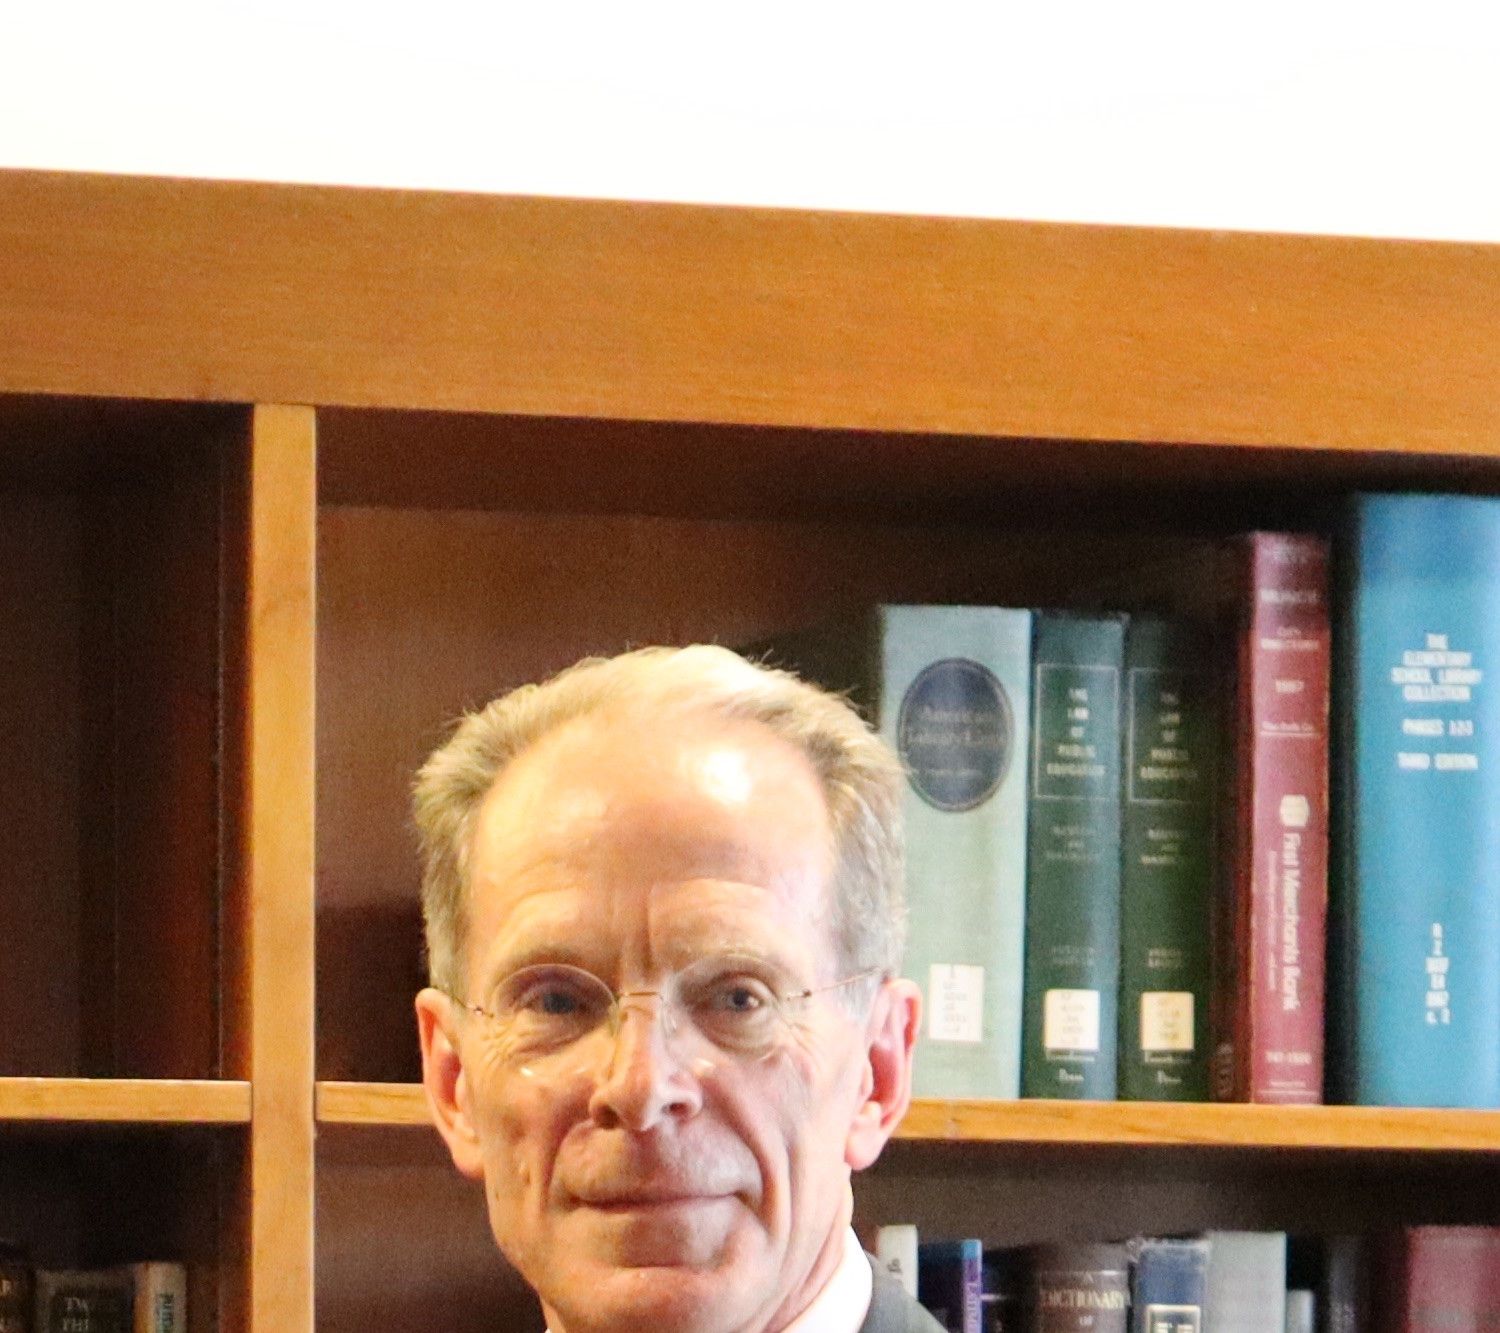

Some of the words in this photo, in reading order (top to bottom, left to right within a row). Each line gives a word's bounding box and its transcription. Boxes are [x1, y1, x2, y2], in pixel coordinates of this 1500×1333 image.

[1281, 832, 1302, 866] First
[1279, 868, 1303, 964] Merchants
[1281, 965, 1303, 1011] Bank
